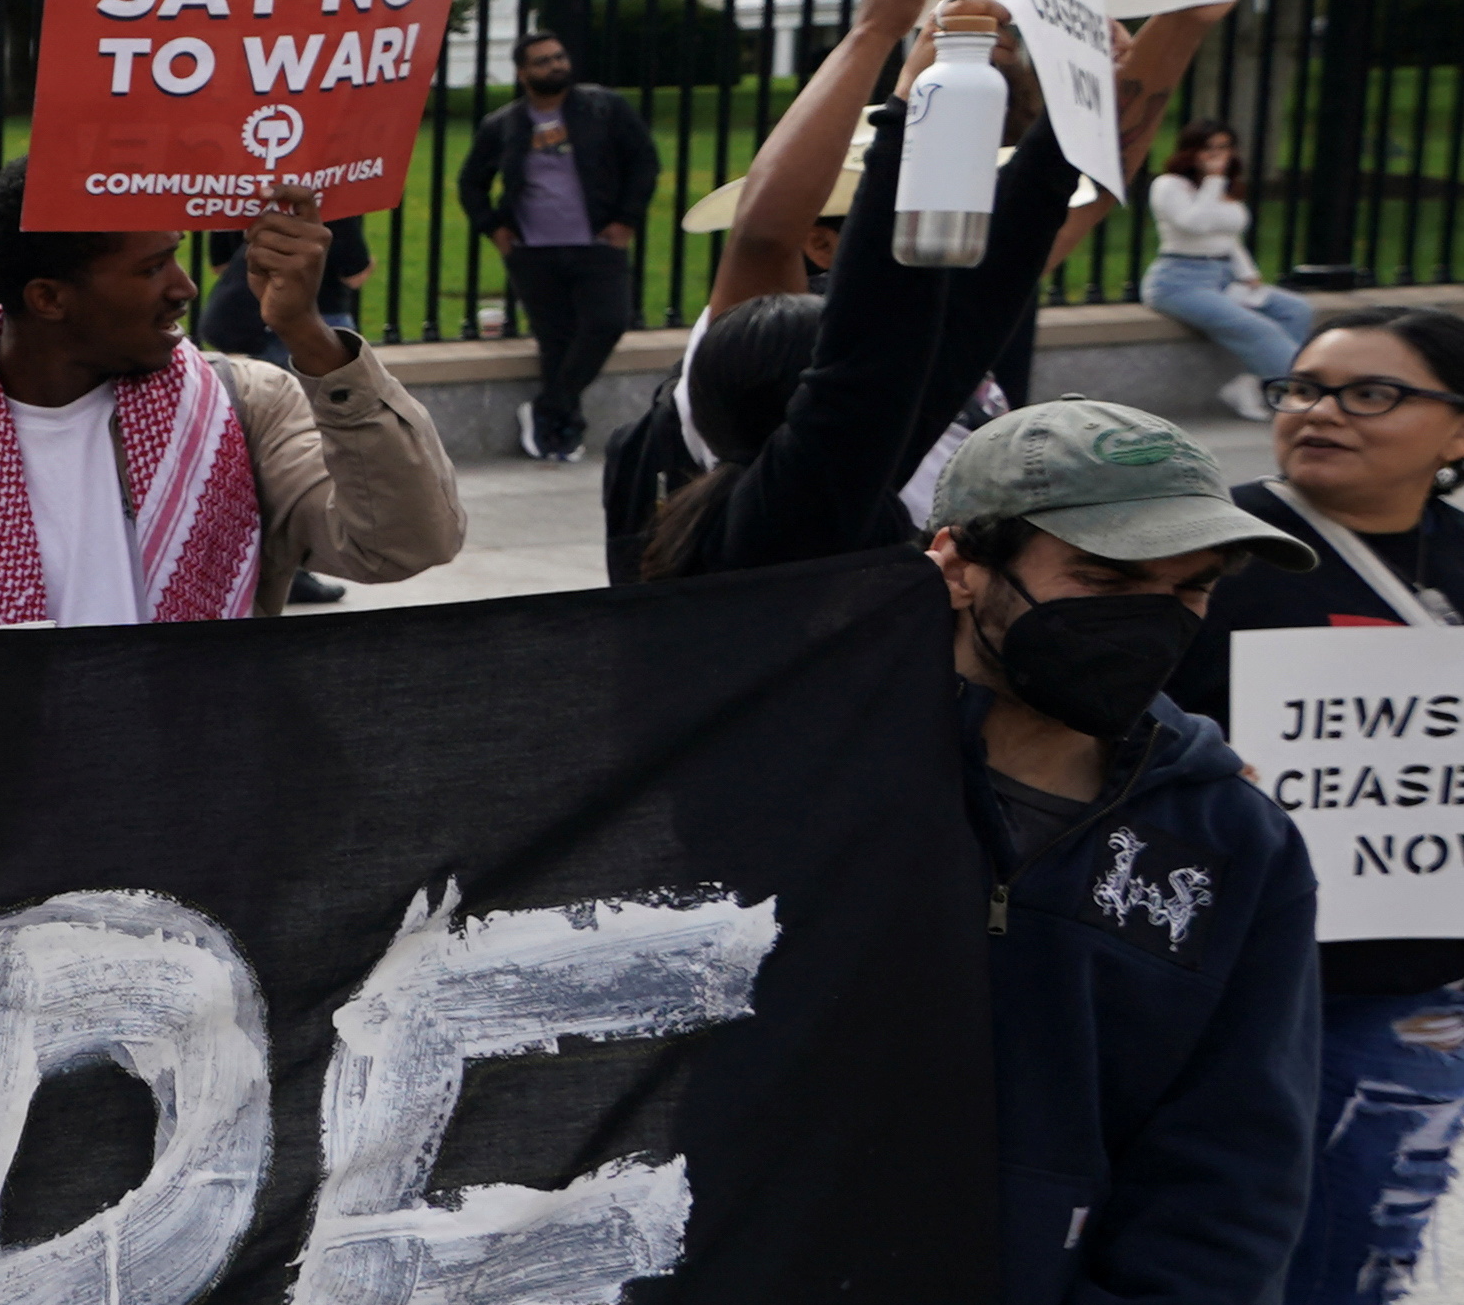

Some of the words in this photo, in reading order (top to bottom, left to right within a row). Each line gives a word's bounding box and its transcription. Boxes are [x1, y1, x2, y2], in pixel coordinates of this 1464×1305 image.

[98, 35, 216, 96] TO
[242, 22, 421, 96] WAR!
[85, 172, 276, 197] COMMUNIST
[346, 157, 384, 183] USA
[1280, 694, 1461, 741] JEWS
[1352, 832, 1464, 876] NO
